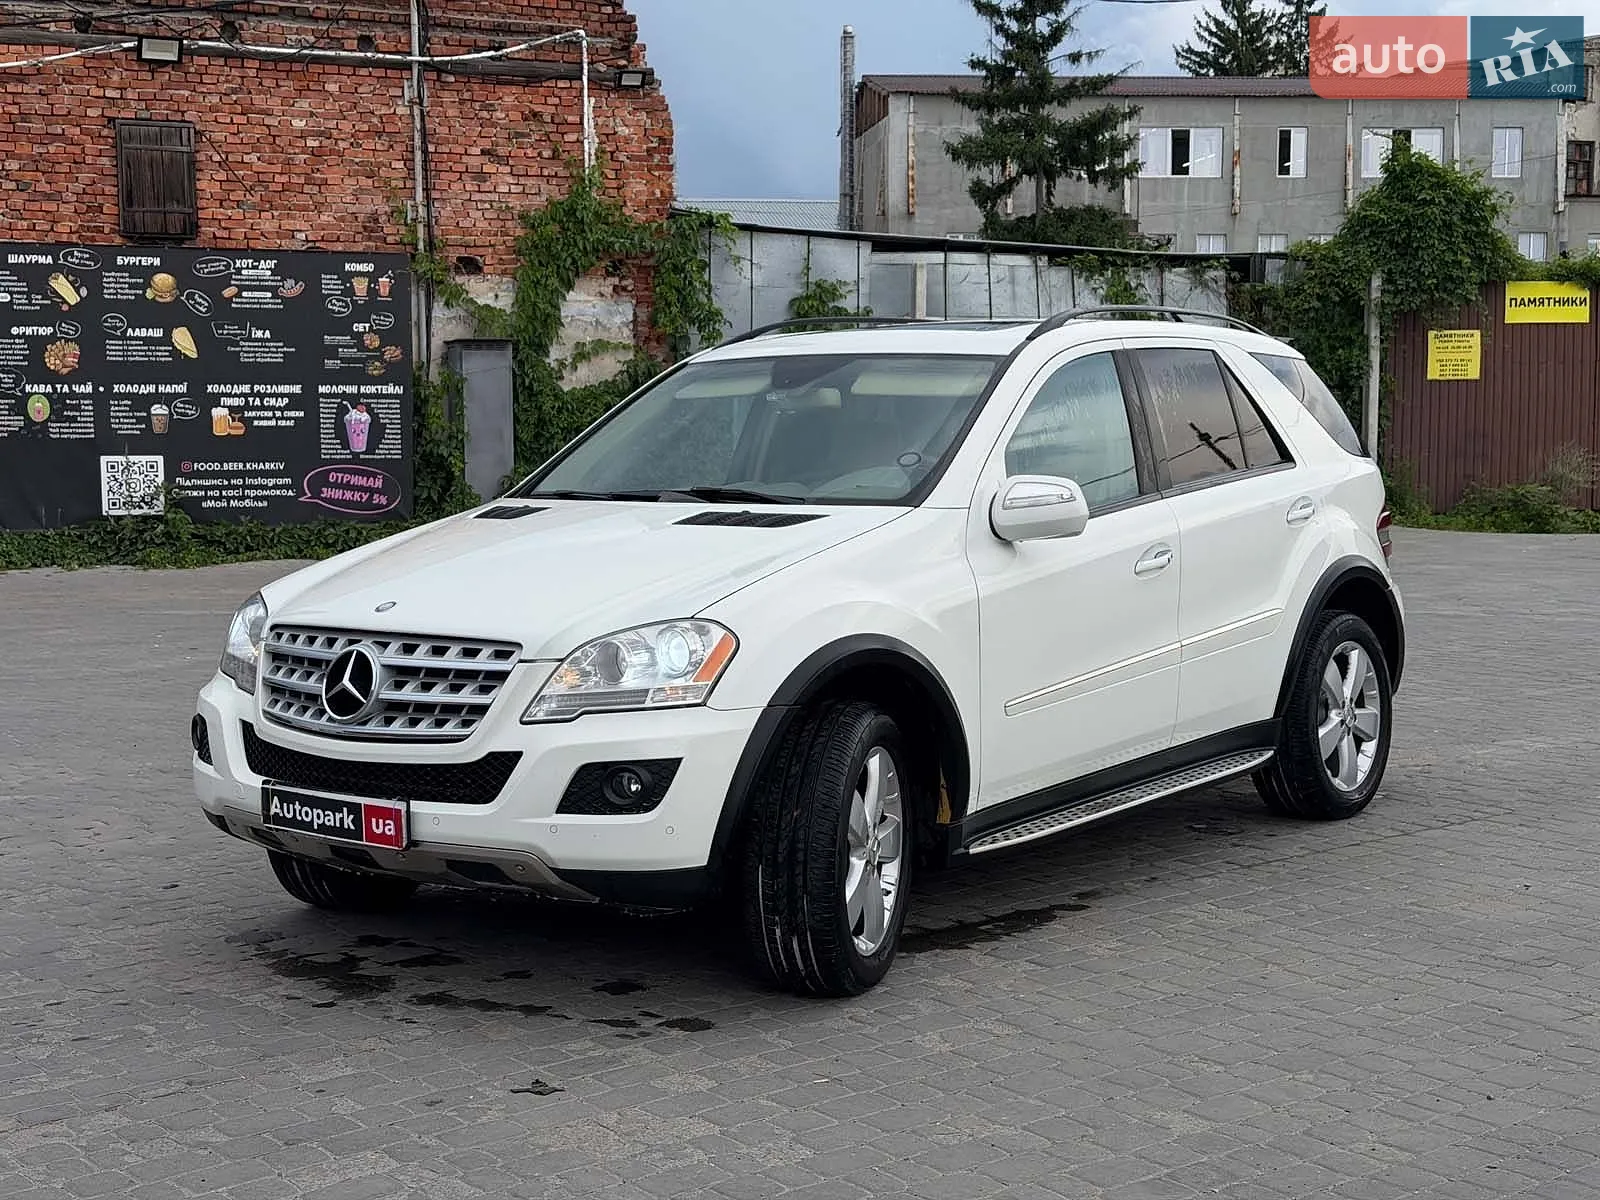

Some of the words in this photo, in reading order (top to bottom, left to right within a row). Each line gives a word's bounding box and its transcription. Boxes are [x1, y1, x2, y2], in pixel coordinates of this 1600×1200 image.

[8, 254, 53, 264] ШАУРМА
[116, 256, 161, 266] БУРГЕРИ
[235, 259, 277, 269] ХОТ-ДОГ
[345, 262, 374, 272] КОМБО
[1509, 296, 1587, 308] ПАМЯТНИКИ
[11, 326, 53, 335] ФРИТЮР
[127, 328, 163, 337] ЛАВАШ
[251, 327, 271, 338] ЇЖА
[353, 323, 370, 332] СЕТ
[25, 384, 53, 393] КАВА
[55, 384, 70, 393] ТА
[72, 382, 93, 393] ЧАЙ
[113, 384, 155, 394] ХОЛОДНІ
[158, 382, 188, 393] НАПОЇ
[206, 384, 251, 394] ХОЛОДНЕ
[253, 384, 302, 394] РОЗЛИВНЕ
[318, 384, 358, 394] МОЛОЧНІ
[360, 383, 404, 394] КОКТЕЙЛІ
[220, 397, 245, 406] ПИВО
[248, 397, 261, 406] ТА
[263, 397, 289, 407] СИДР
[193, 462, 285, 471] FOOD.BEER.KHARKIV
[175, 477, 228, 486] Підпишись
[245, 477, 292, 487] Instagram
[329, 472, 383, 488] ОТРИМАЙ
[222, 488, 242, 497] касі
[244, 489, 297, 498] промокод:
[320, 487, 370, 503] ЗНИЖКУ
[372, 493, 389, 505] 5%
[271, 795, 355, 830] Autopark
[371, 816, 396, 836] ua
